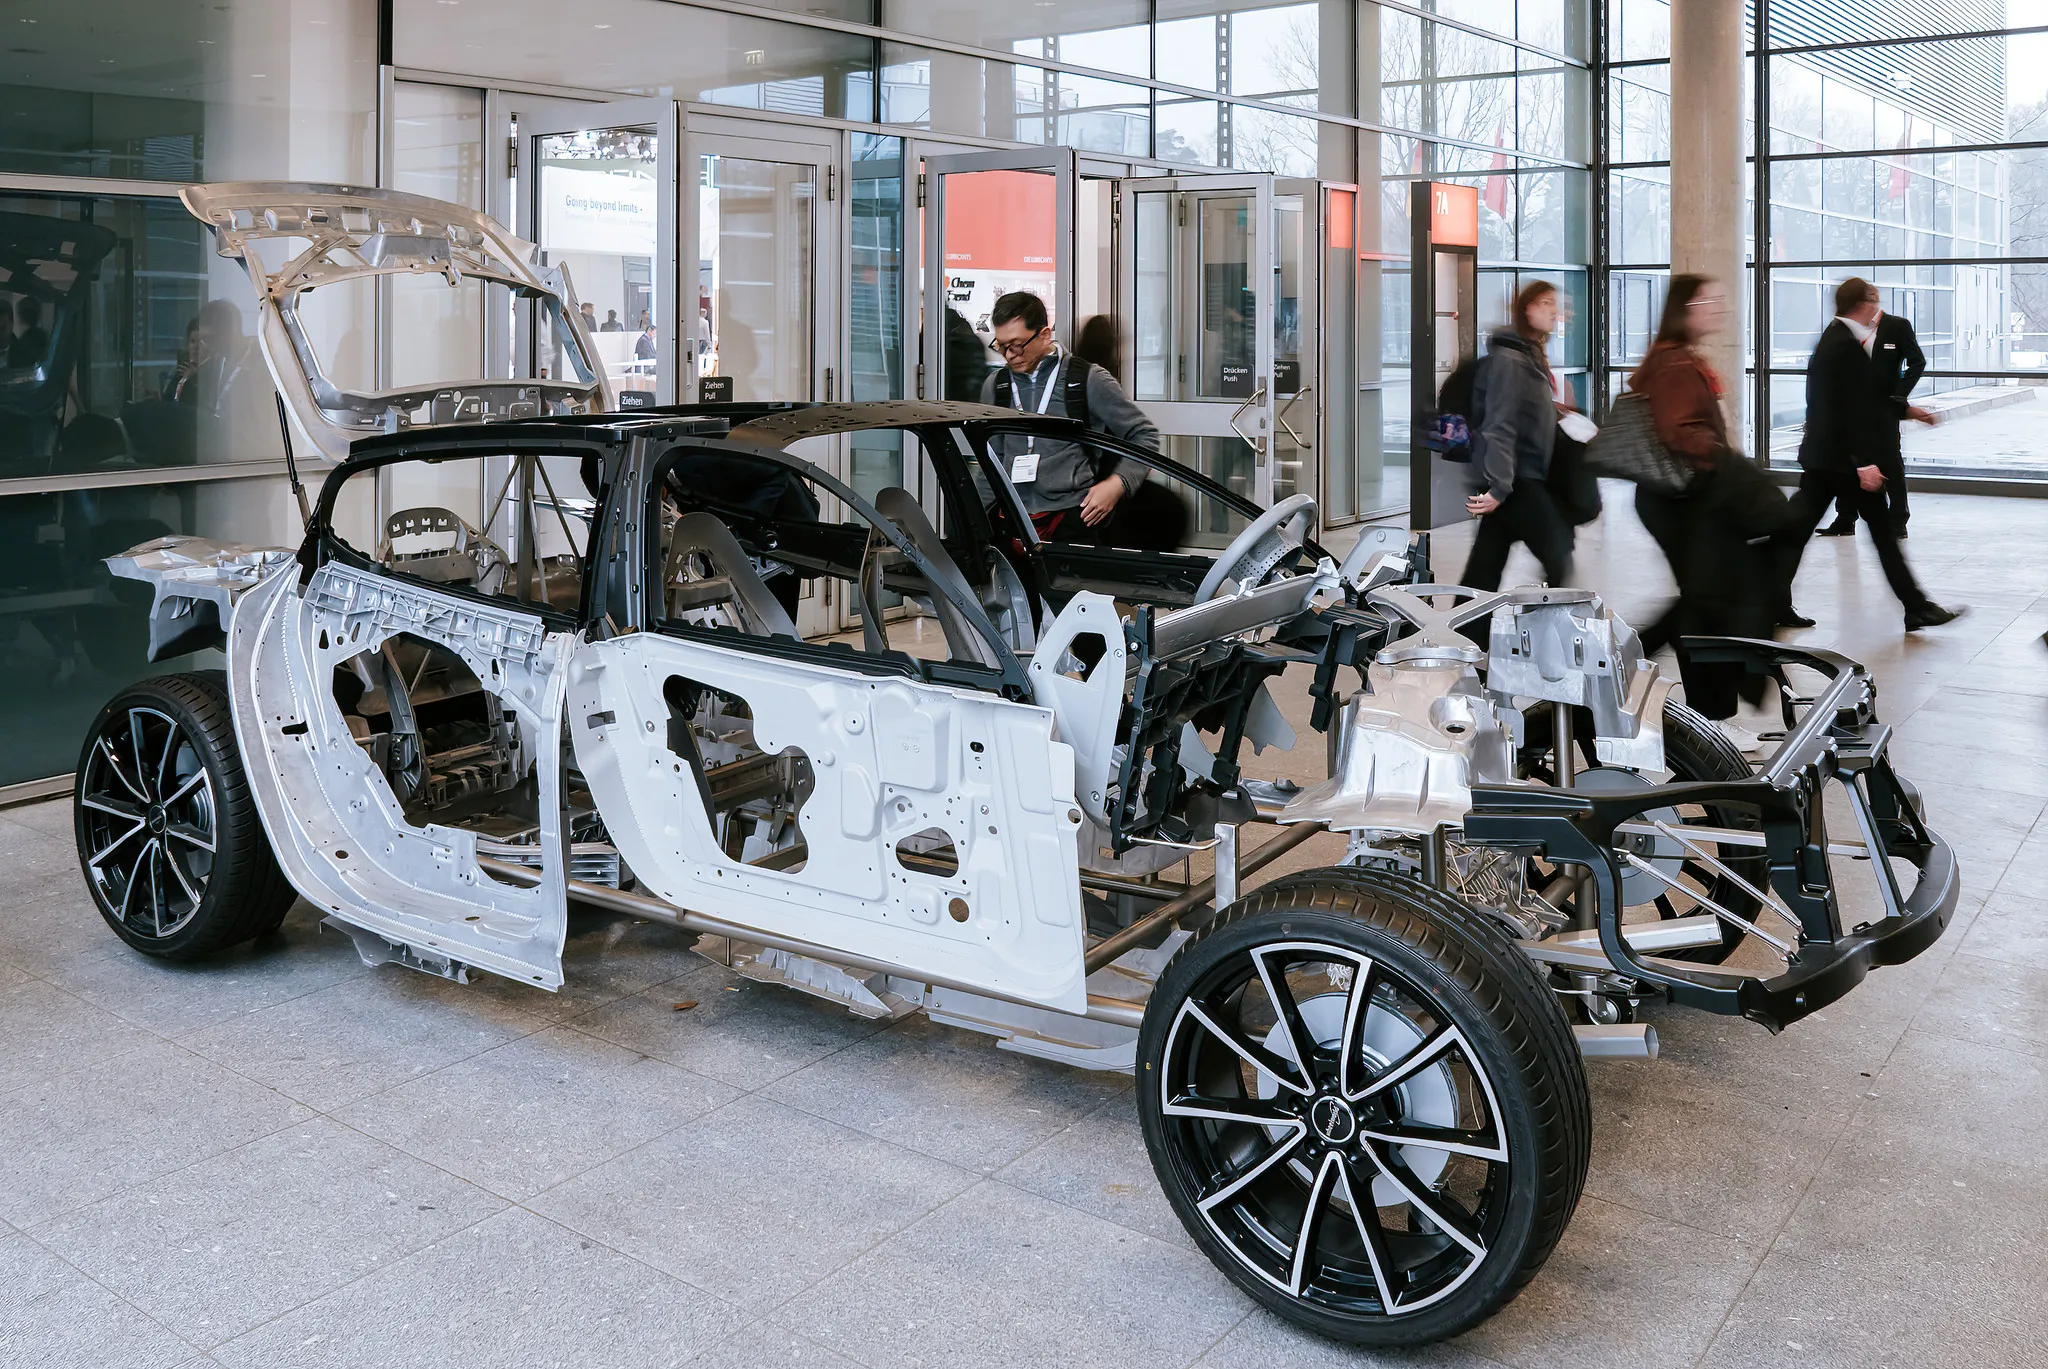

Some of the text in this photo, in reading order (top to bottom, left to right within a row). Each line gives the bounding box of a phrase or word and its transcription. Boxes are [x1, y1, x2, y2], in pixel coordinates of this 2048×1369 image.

[565, 194, 588, 211] Going
[589, 197, 617, 213] beyond
[618, 200, 638, 214] limits
[1436, 191, 1449, 215] 7A
[1223, 366, 1248, 374] Drücken
[704, 381, 725, 389] Ziehen
[622, 395, 643, 406] Ziehen
[704, 392, 716, 400] Pull
